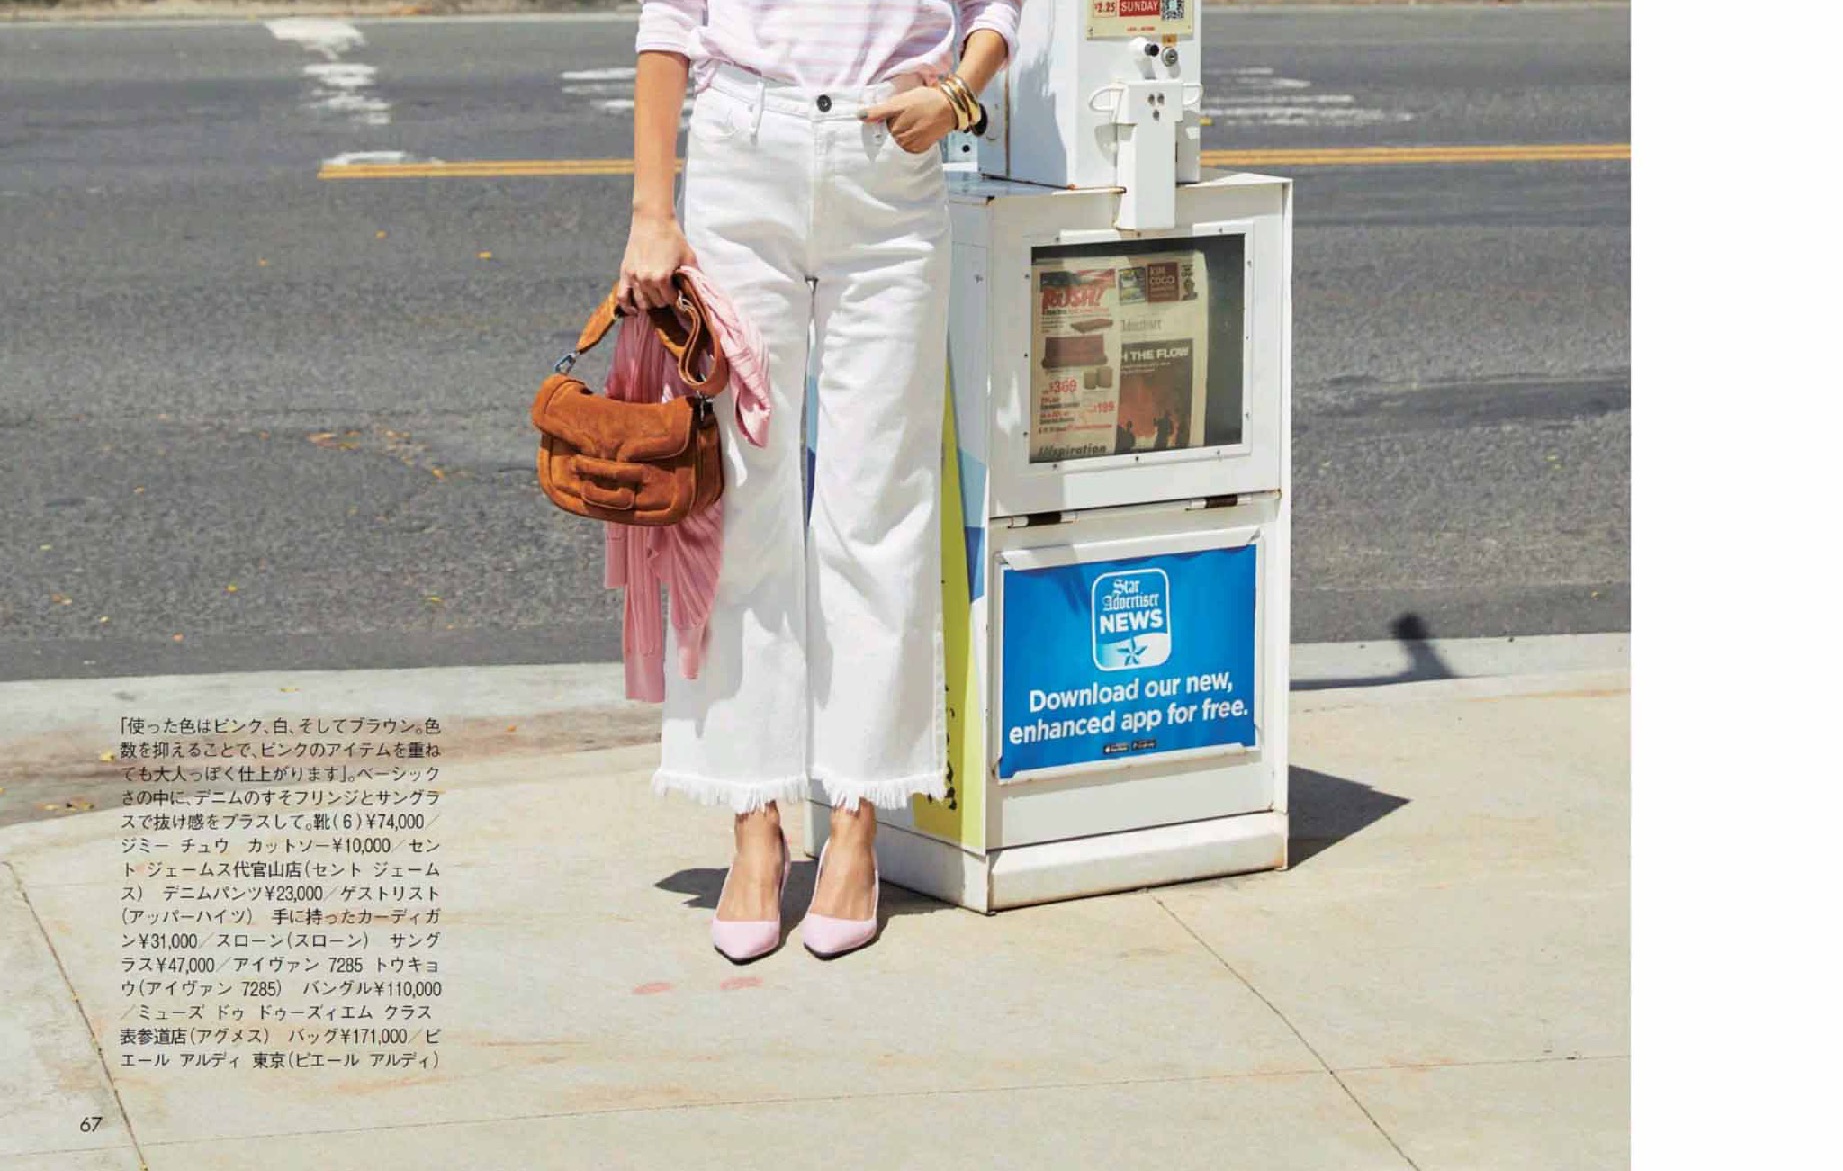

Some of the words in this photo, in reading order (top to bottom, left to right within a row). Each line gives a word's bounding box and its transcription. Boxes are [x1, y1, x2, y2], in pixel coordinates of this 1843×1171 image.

[1120, 0, 1159, 12] SUNDAY
[1130, 349, 1155, 363] THE
[1156, 346, 1189, 360] FLOW
[1113, 579, 1140, 595] Star
[1102, 594, 1159, 612] Advertiser
[1100, 608, 1164, 635] NEWS
[1029, 678, 1139, 713] Download
[1144, 678, 1181, 698] our
[1186, 671, 1233, 693] new,
[1009, 710, 1115, 744] enhanced
[1121, 711, 1163, 734] app
[1167, 702, 1198, 725] for
[1201, 698, 1249, 721] free.
